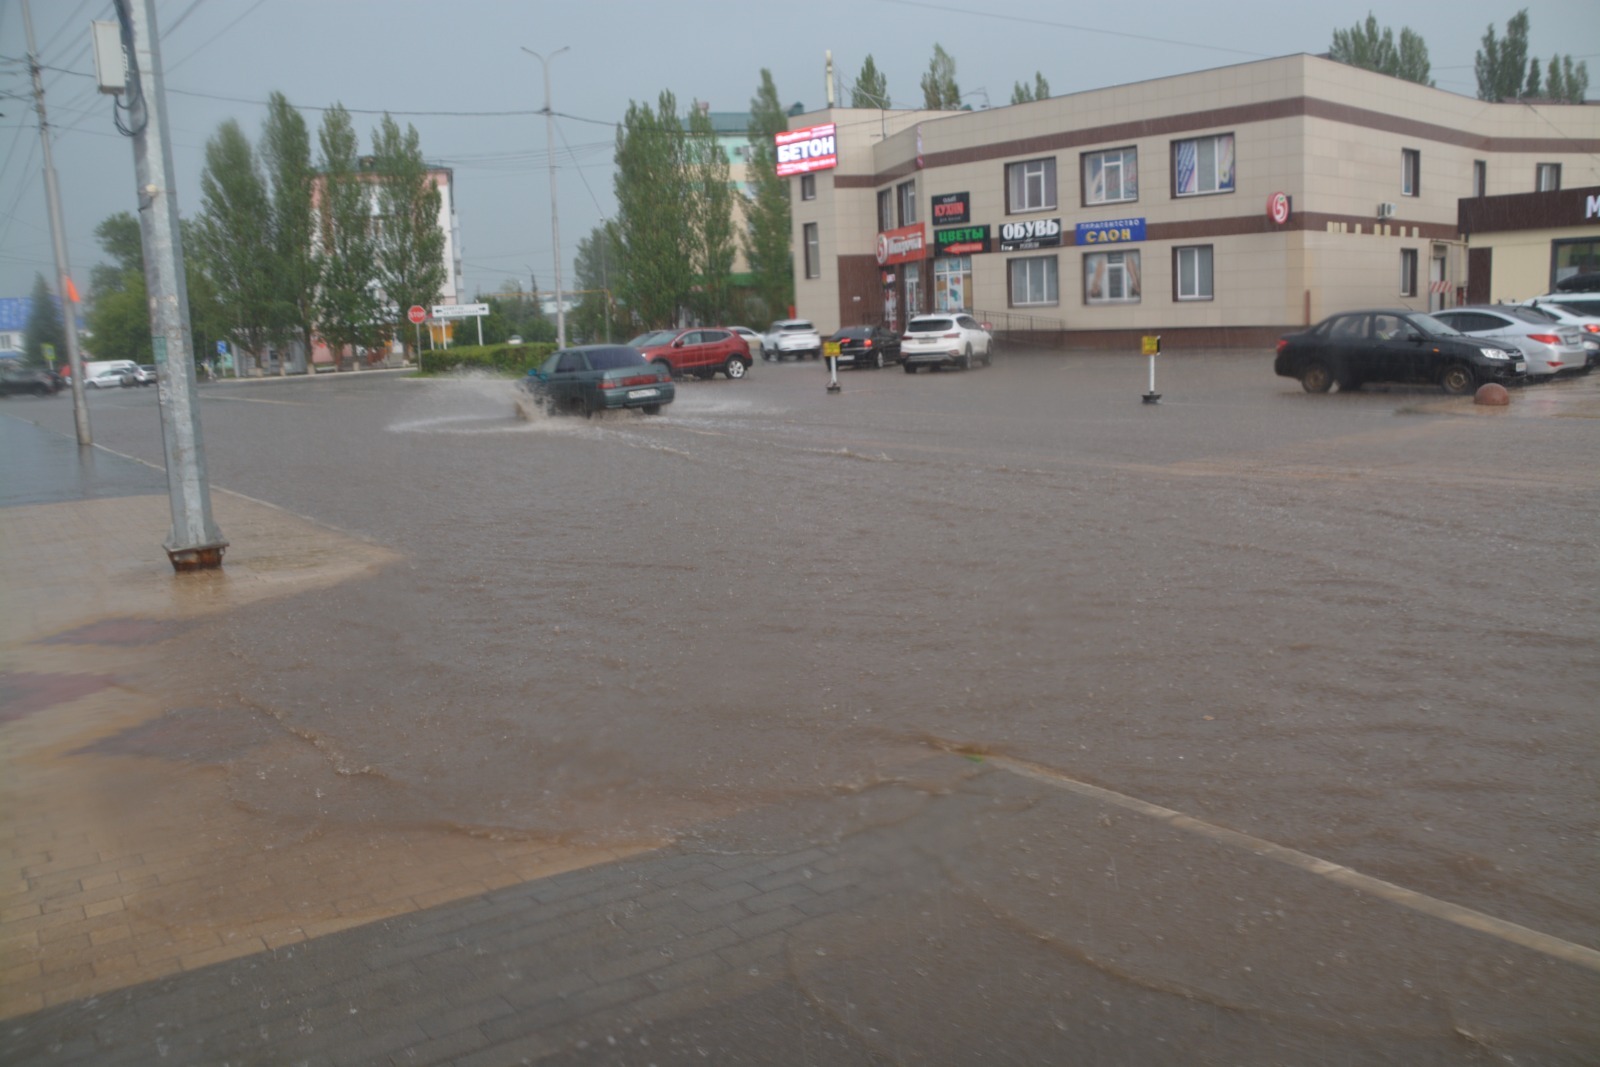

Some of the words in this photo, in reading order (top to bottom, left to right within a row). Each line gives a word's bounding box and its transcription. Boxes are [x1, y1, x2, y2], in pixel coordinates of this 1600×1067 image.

[777, 135, 835, 163] БЕТОН
[934, 201, 965, 217] КУХНИ
[938, 227, 984, 244] ЦВЕТЫ
[1002, 219, 1059, 240] ОБУВЬ
[1085, 228, 1132, 243] СЛОН
